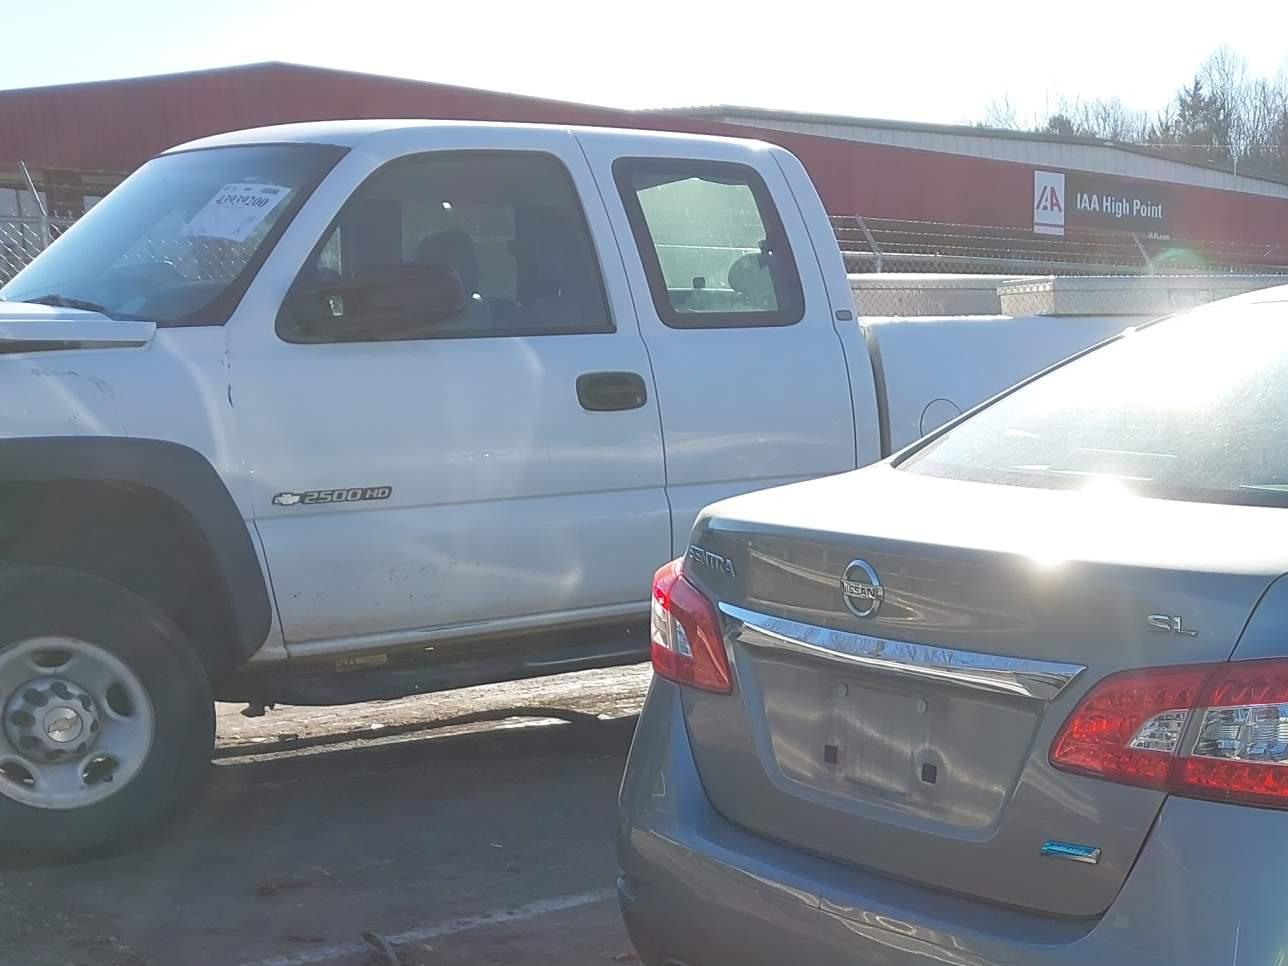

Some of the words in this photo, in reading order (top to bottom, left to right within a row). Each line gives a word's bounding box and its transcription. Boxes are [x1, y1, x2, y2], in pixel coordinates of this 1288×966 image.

[1076, 192, 1100, 212] IAA
[1102, 195, 1130, 218] High
[1133, 199, 1163, 218] Point
[303, 489, 362, 504] 2500
[366, 487, 390, 500] HD
[688, 545, 736, 577] SENTRA
[842, 581, 877, 600] NISSAN
[1146, 613, 1199, 637] SL
